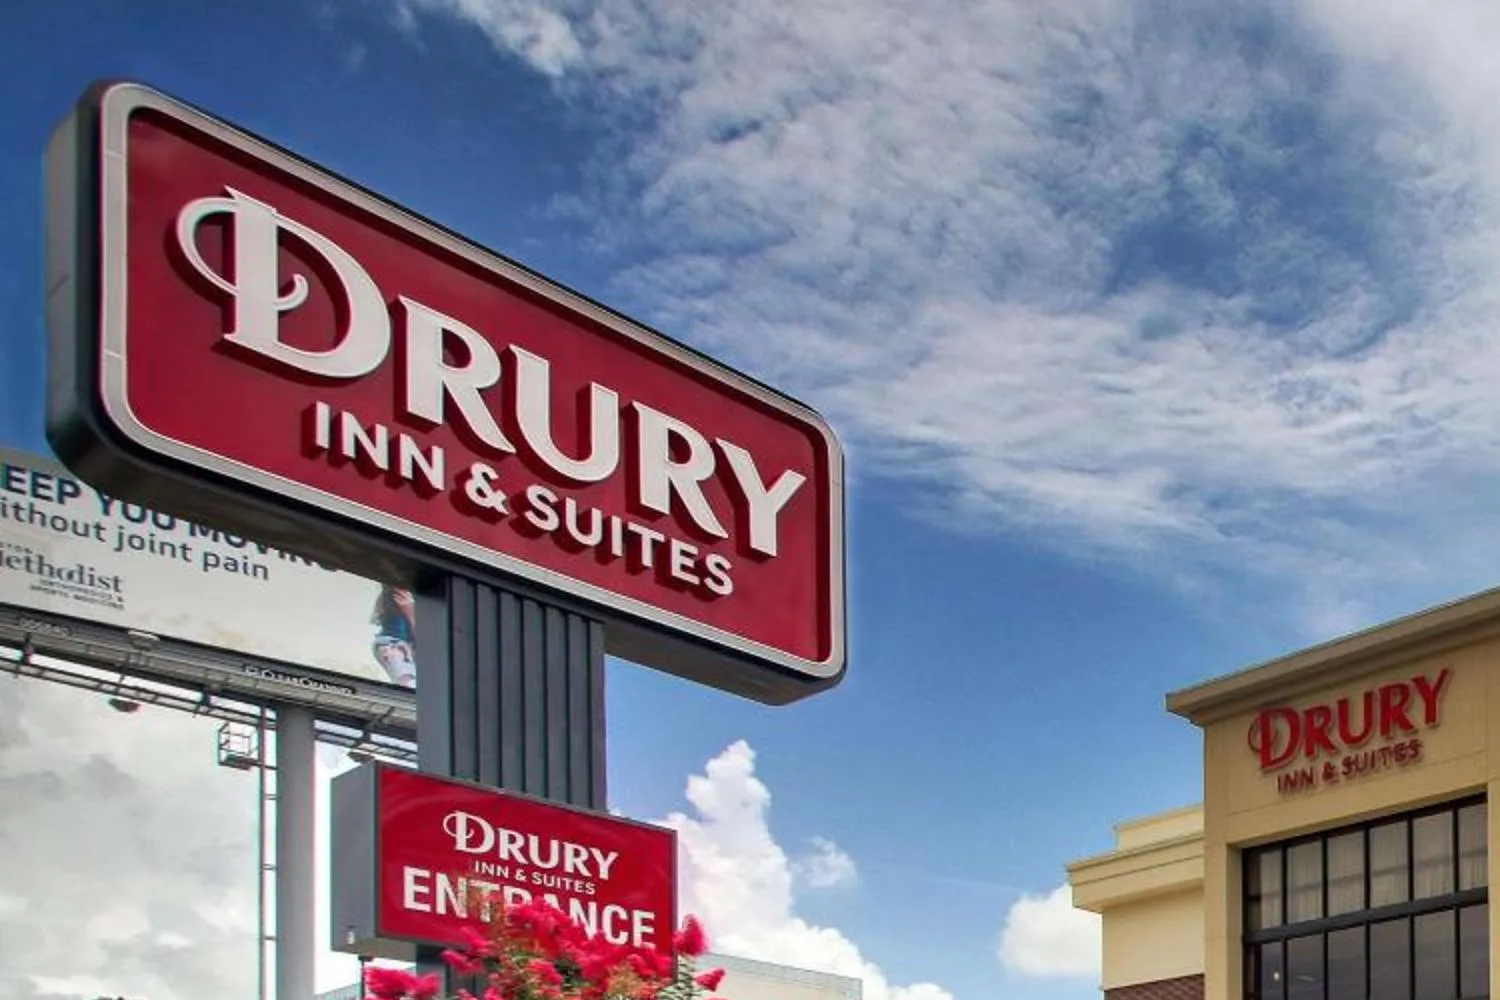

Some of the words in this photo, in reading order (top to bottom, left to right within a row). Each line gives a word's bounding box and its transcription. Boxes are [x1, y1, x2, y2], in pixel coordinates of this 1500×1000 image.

[175, 184, 806, 557] DRURY
[316, 401, 444, 491] INN
[464, 462, 510, 515] &
[526, 484, 734, 596] SUITES
[0, 553, 124, 593] ethodist
[114, 525, 192, 563] joint
[203, 551, 269, 581] pain
[1248, 668, 1451, 770] DRURY
[1277, 767, 1315, 793] INN
[1341, 738, 1423, 778] SUITES
[443, 810, 619, 880] DRURY
[475, 860, 509, 880] INN
[515, 868, 528, 883] &
[532, 871, 597, 895] SUITES
